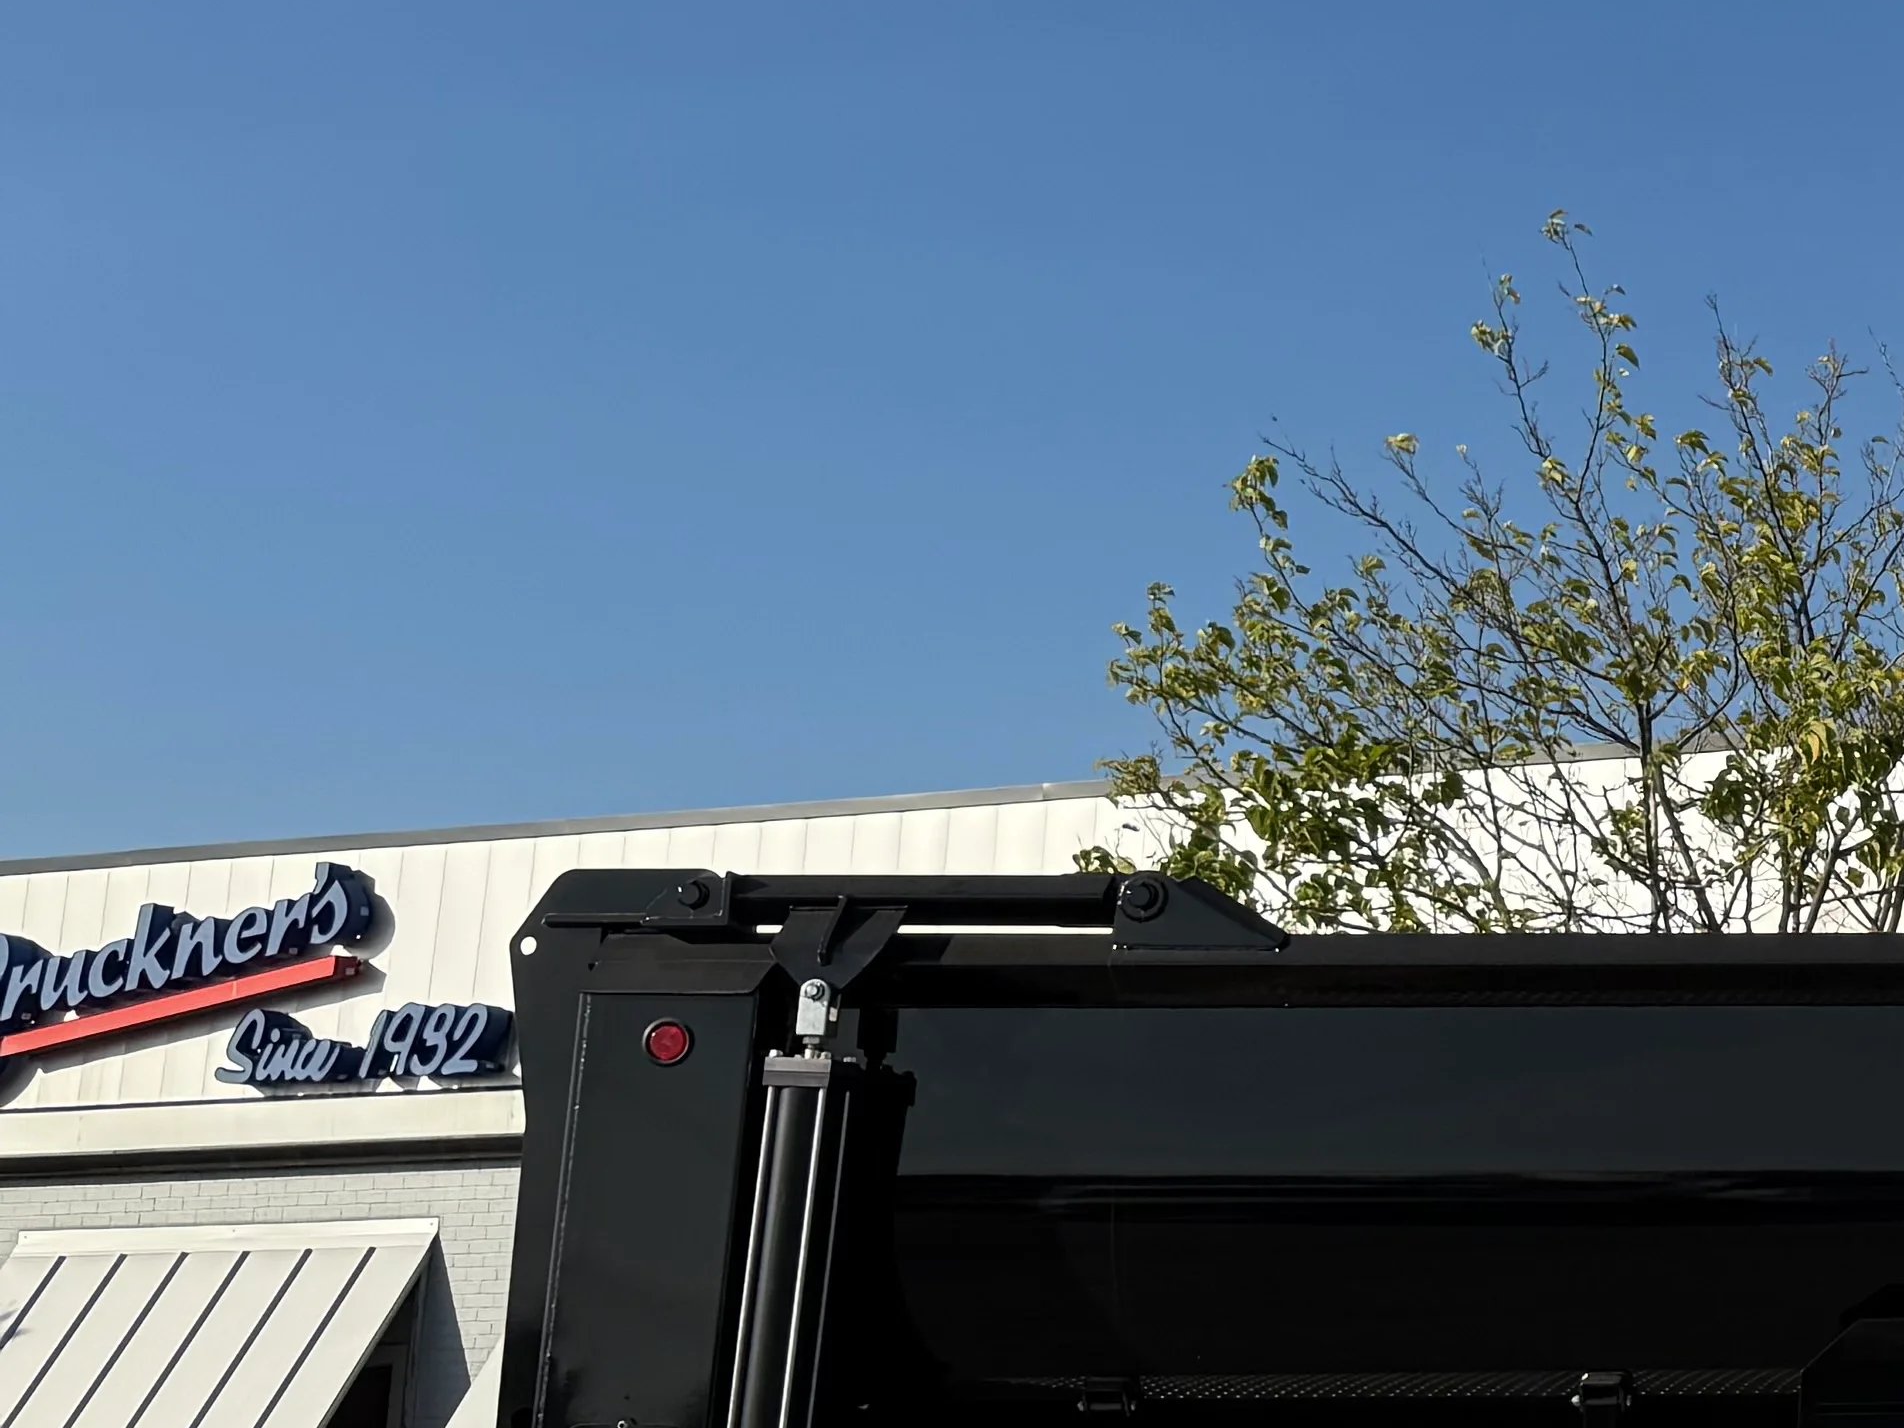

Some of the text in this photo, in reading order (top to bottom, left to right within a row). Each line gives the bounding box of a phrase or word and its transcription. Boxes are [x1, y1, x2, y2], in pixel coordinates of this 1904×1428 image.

[0, 862, 349, 1022] ruckner's
[215, 1002, 488, 1084] Since 1932
